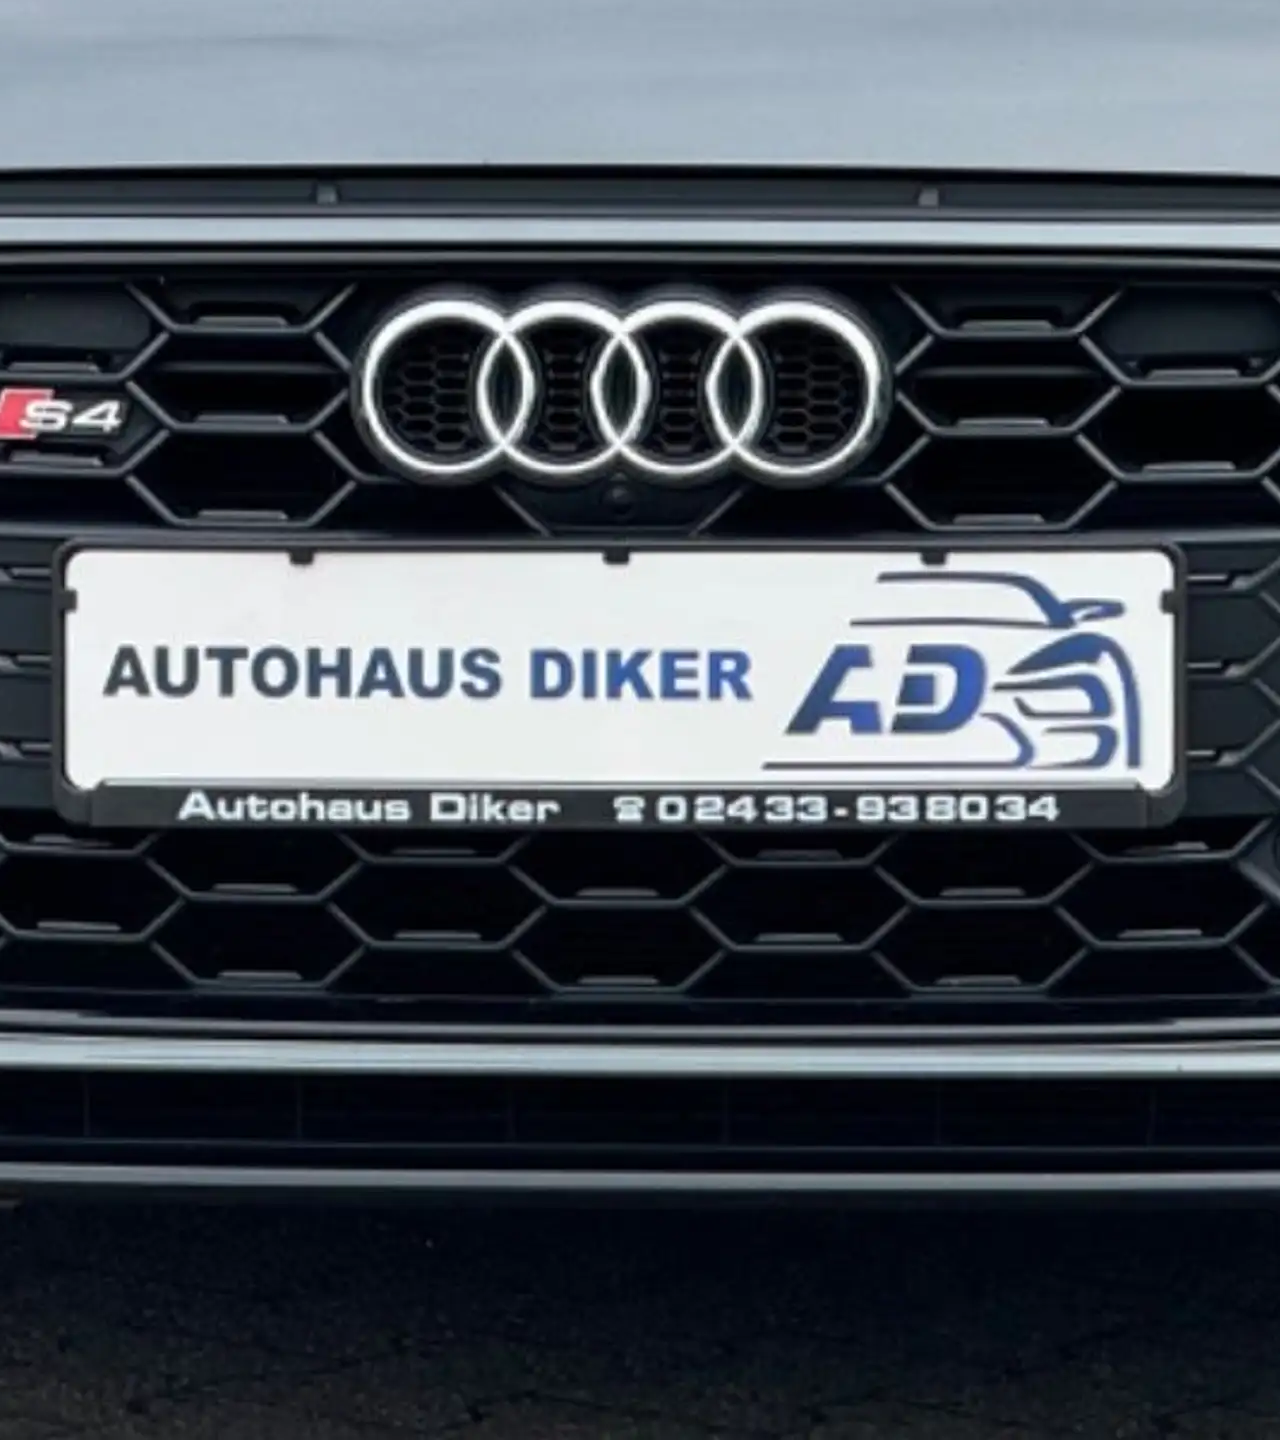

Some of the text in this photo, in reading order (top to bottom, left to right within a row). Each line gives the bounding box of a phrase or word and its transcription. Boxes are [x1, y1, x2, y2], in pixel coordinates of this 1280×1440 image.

[18, 399, 122, 432] S4
[103, 646, 502, 699] AUTOHAUS
[529, 648, 753, 702] DIKER
[178, 791, 412, 824] Autohaus
[431, 794, 560, 824] Diker
